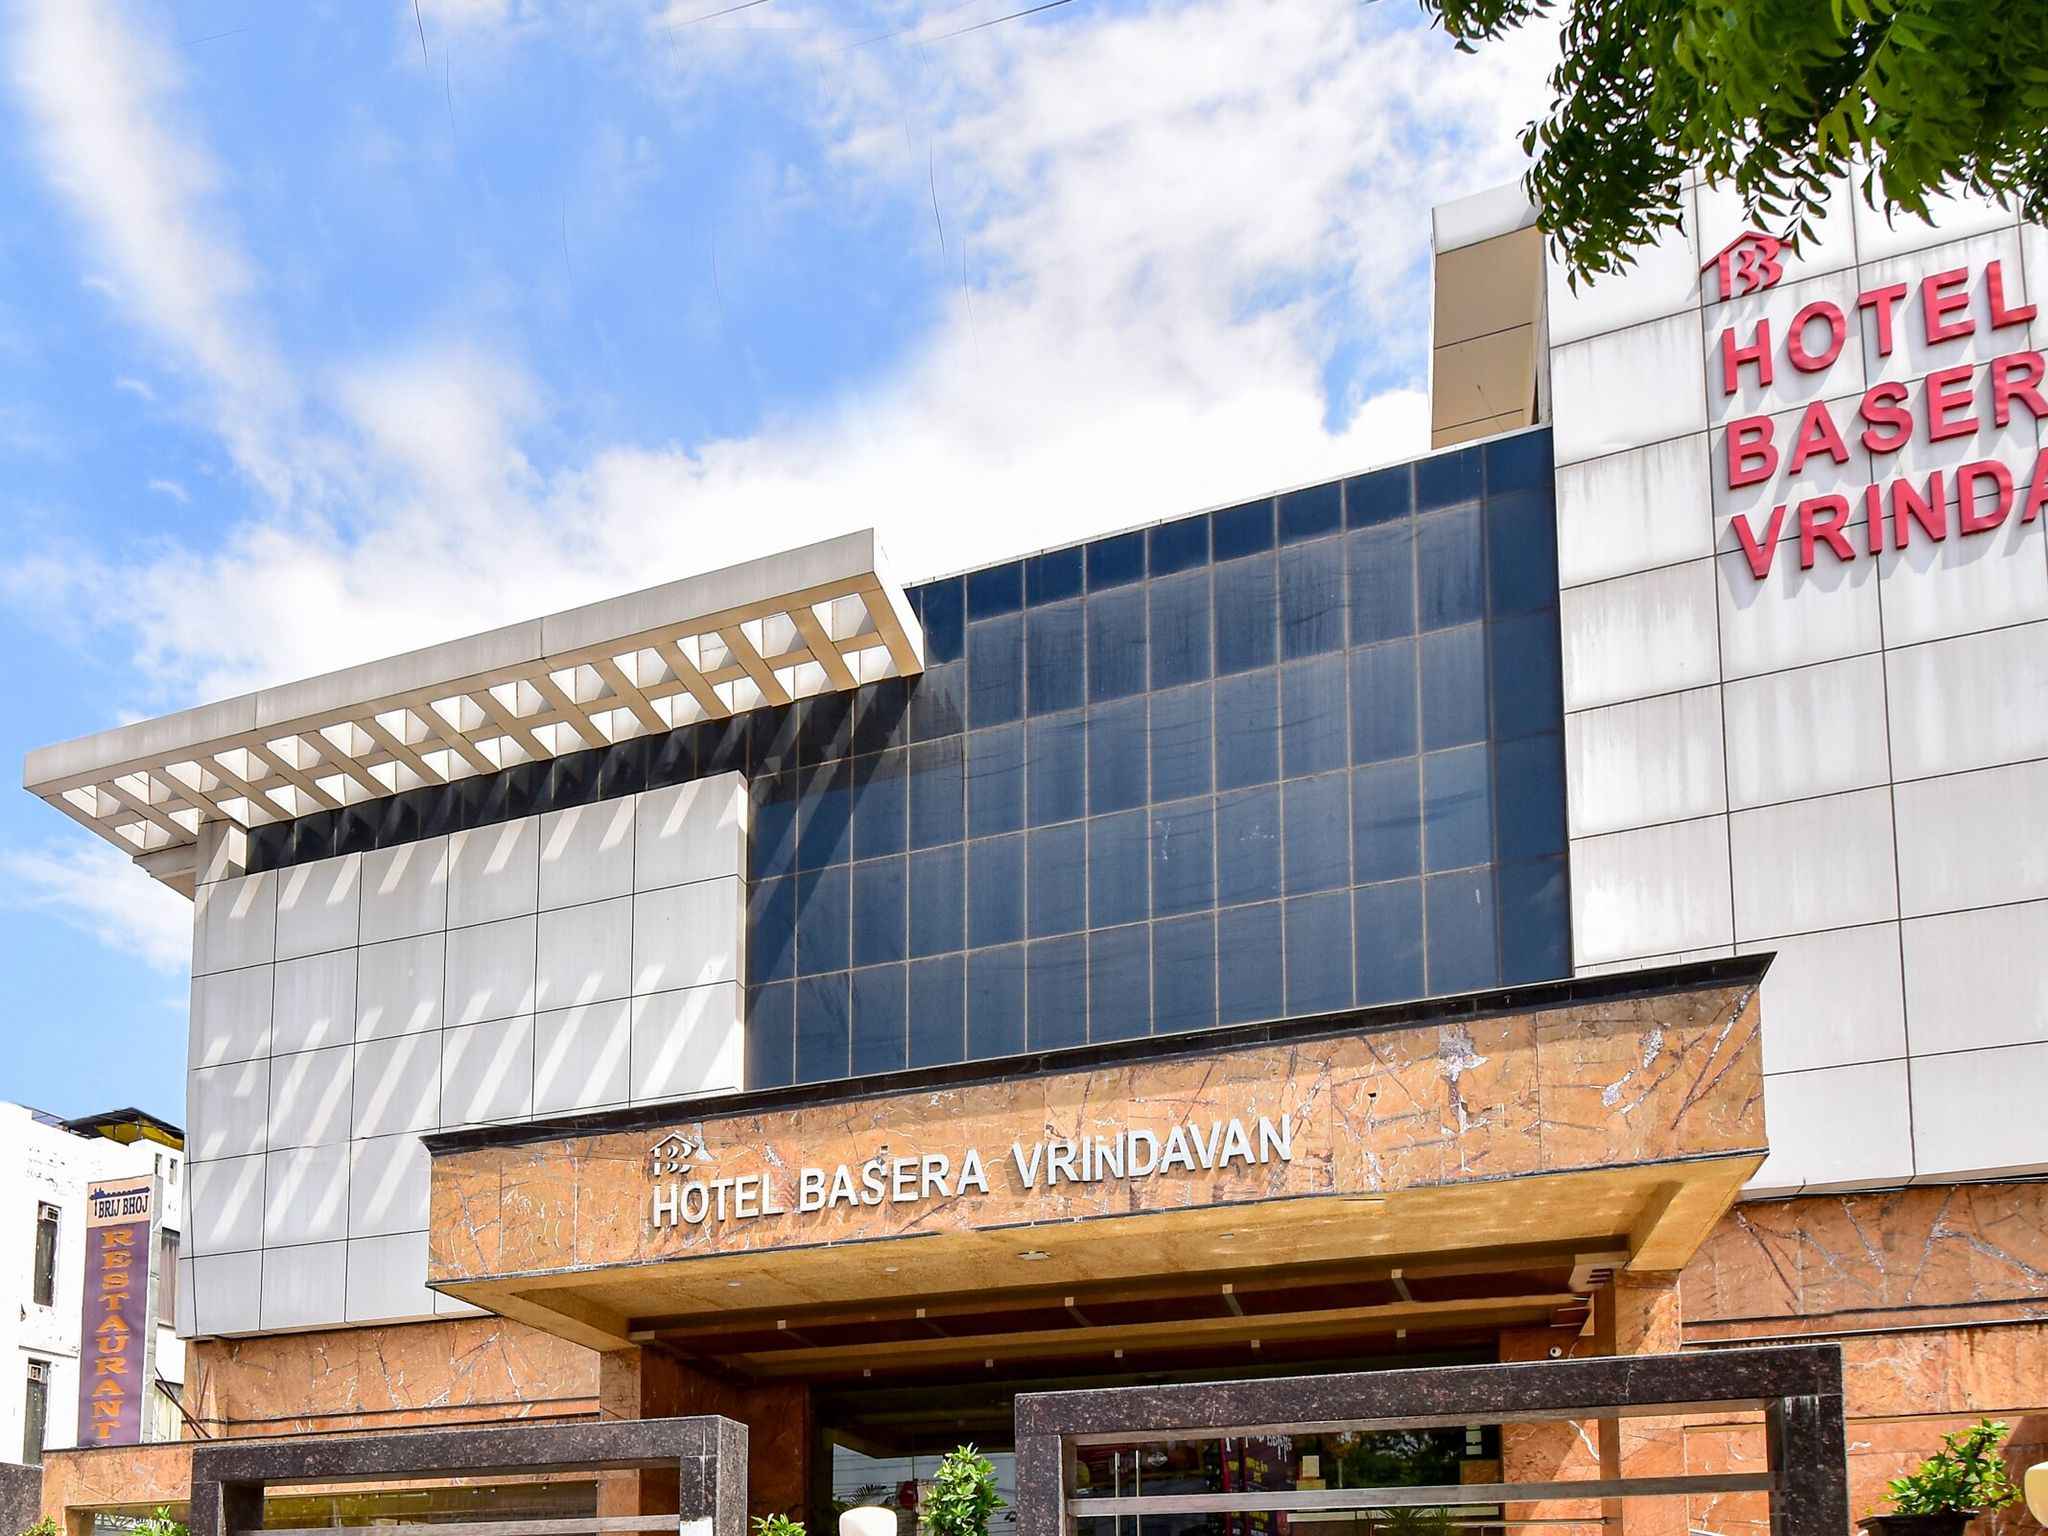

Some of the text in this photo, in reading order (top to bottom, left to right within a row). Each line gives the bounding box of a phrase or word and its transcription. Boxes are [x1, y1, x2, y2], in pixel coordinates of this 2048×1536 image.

[1721, 259, 2038, 396] HOTEL
[1726, 350, 2048, 490] BASER
[98, 1195, 149, 1218] BRIJ BHOJ
[653, 1113, 1293, 1228] HOTEL BASERA VRINDAVAN
[90, 1229, 137, 1440] RESTAURANT
